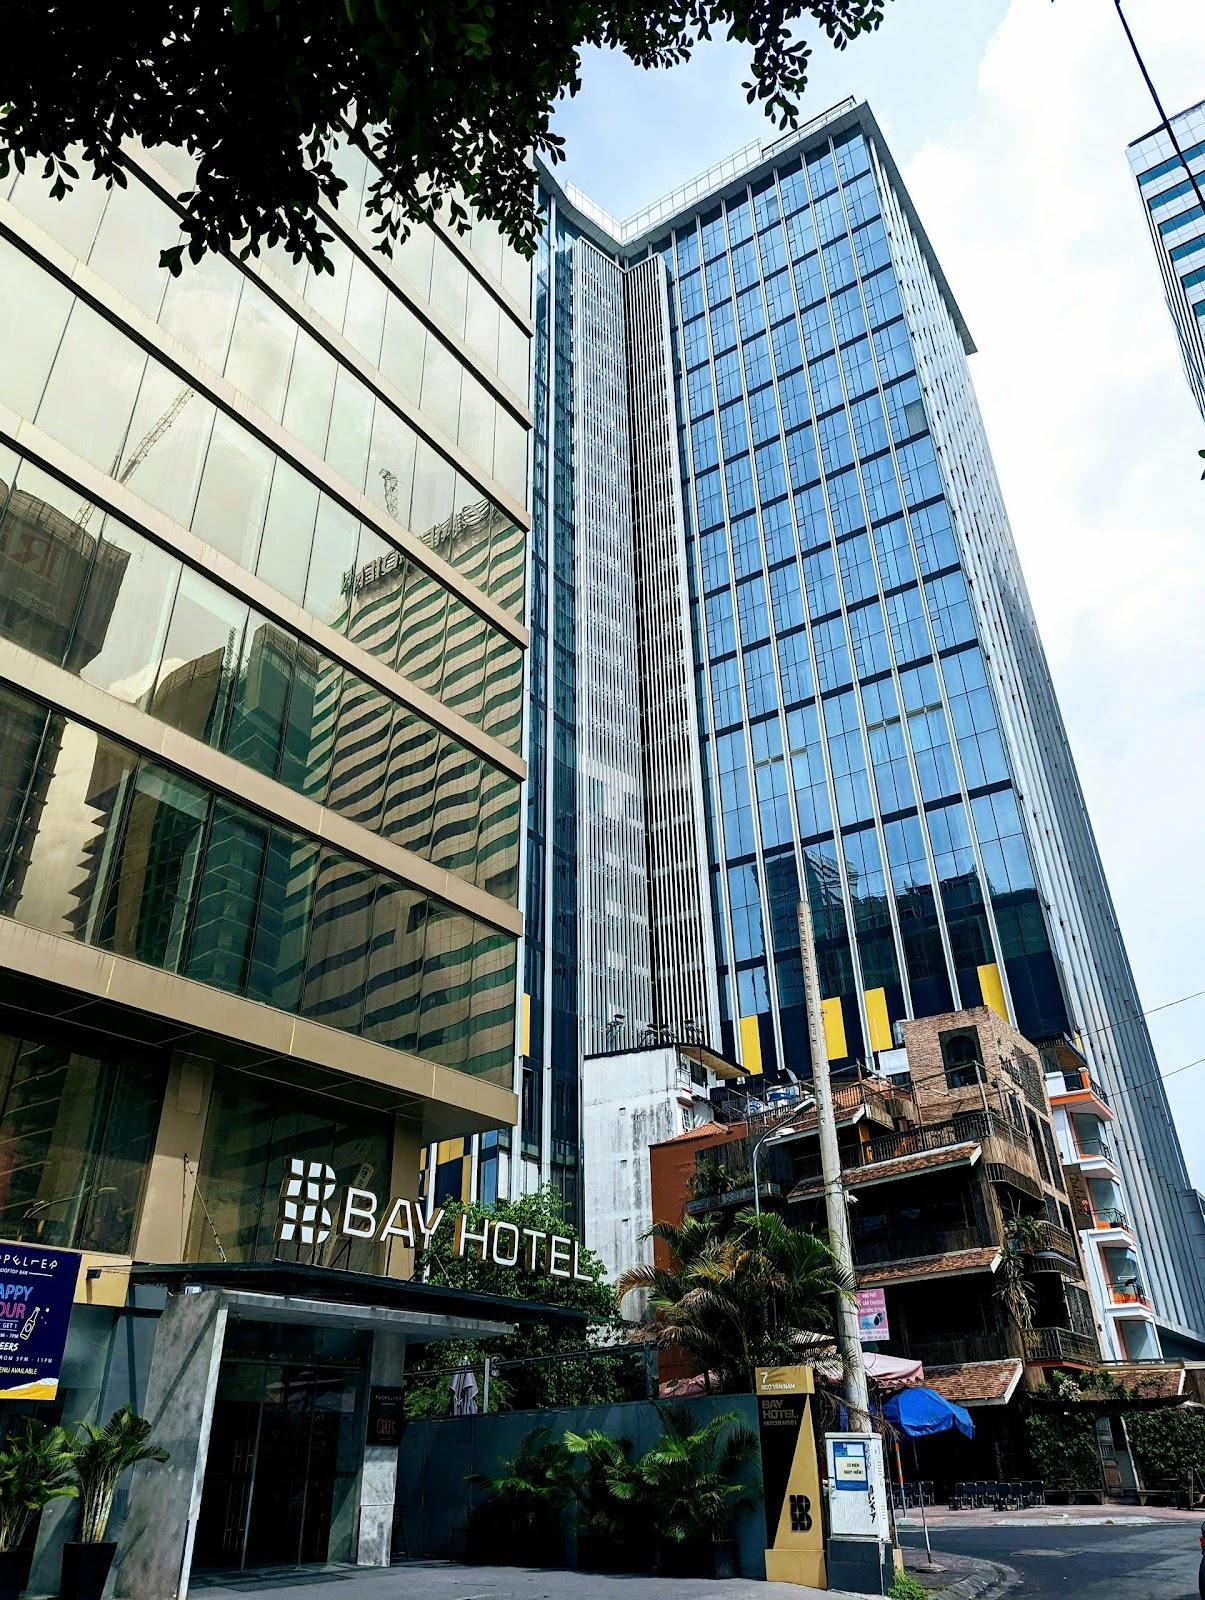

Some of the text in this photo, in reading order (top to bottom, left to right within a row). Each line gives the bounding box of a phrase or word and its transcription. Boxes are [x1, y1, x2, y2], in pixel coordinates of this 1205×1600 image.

[342, 1187, 595, 1283] BAY HOTEL
[10, 1367, 38, 1375] AVAILABLE
[760, 1371, 768, 1384] 7
[762, 1400, 783, 1409] BAY
